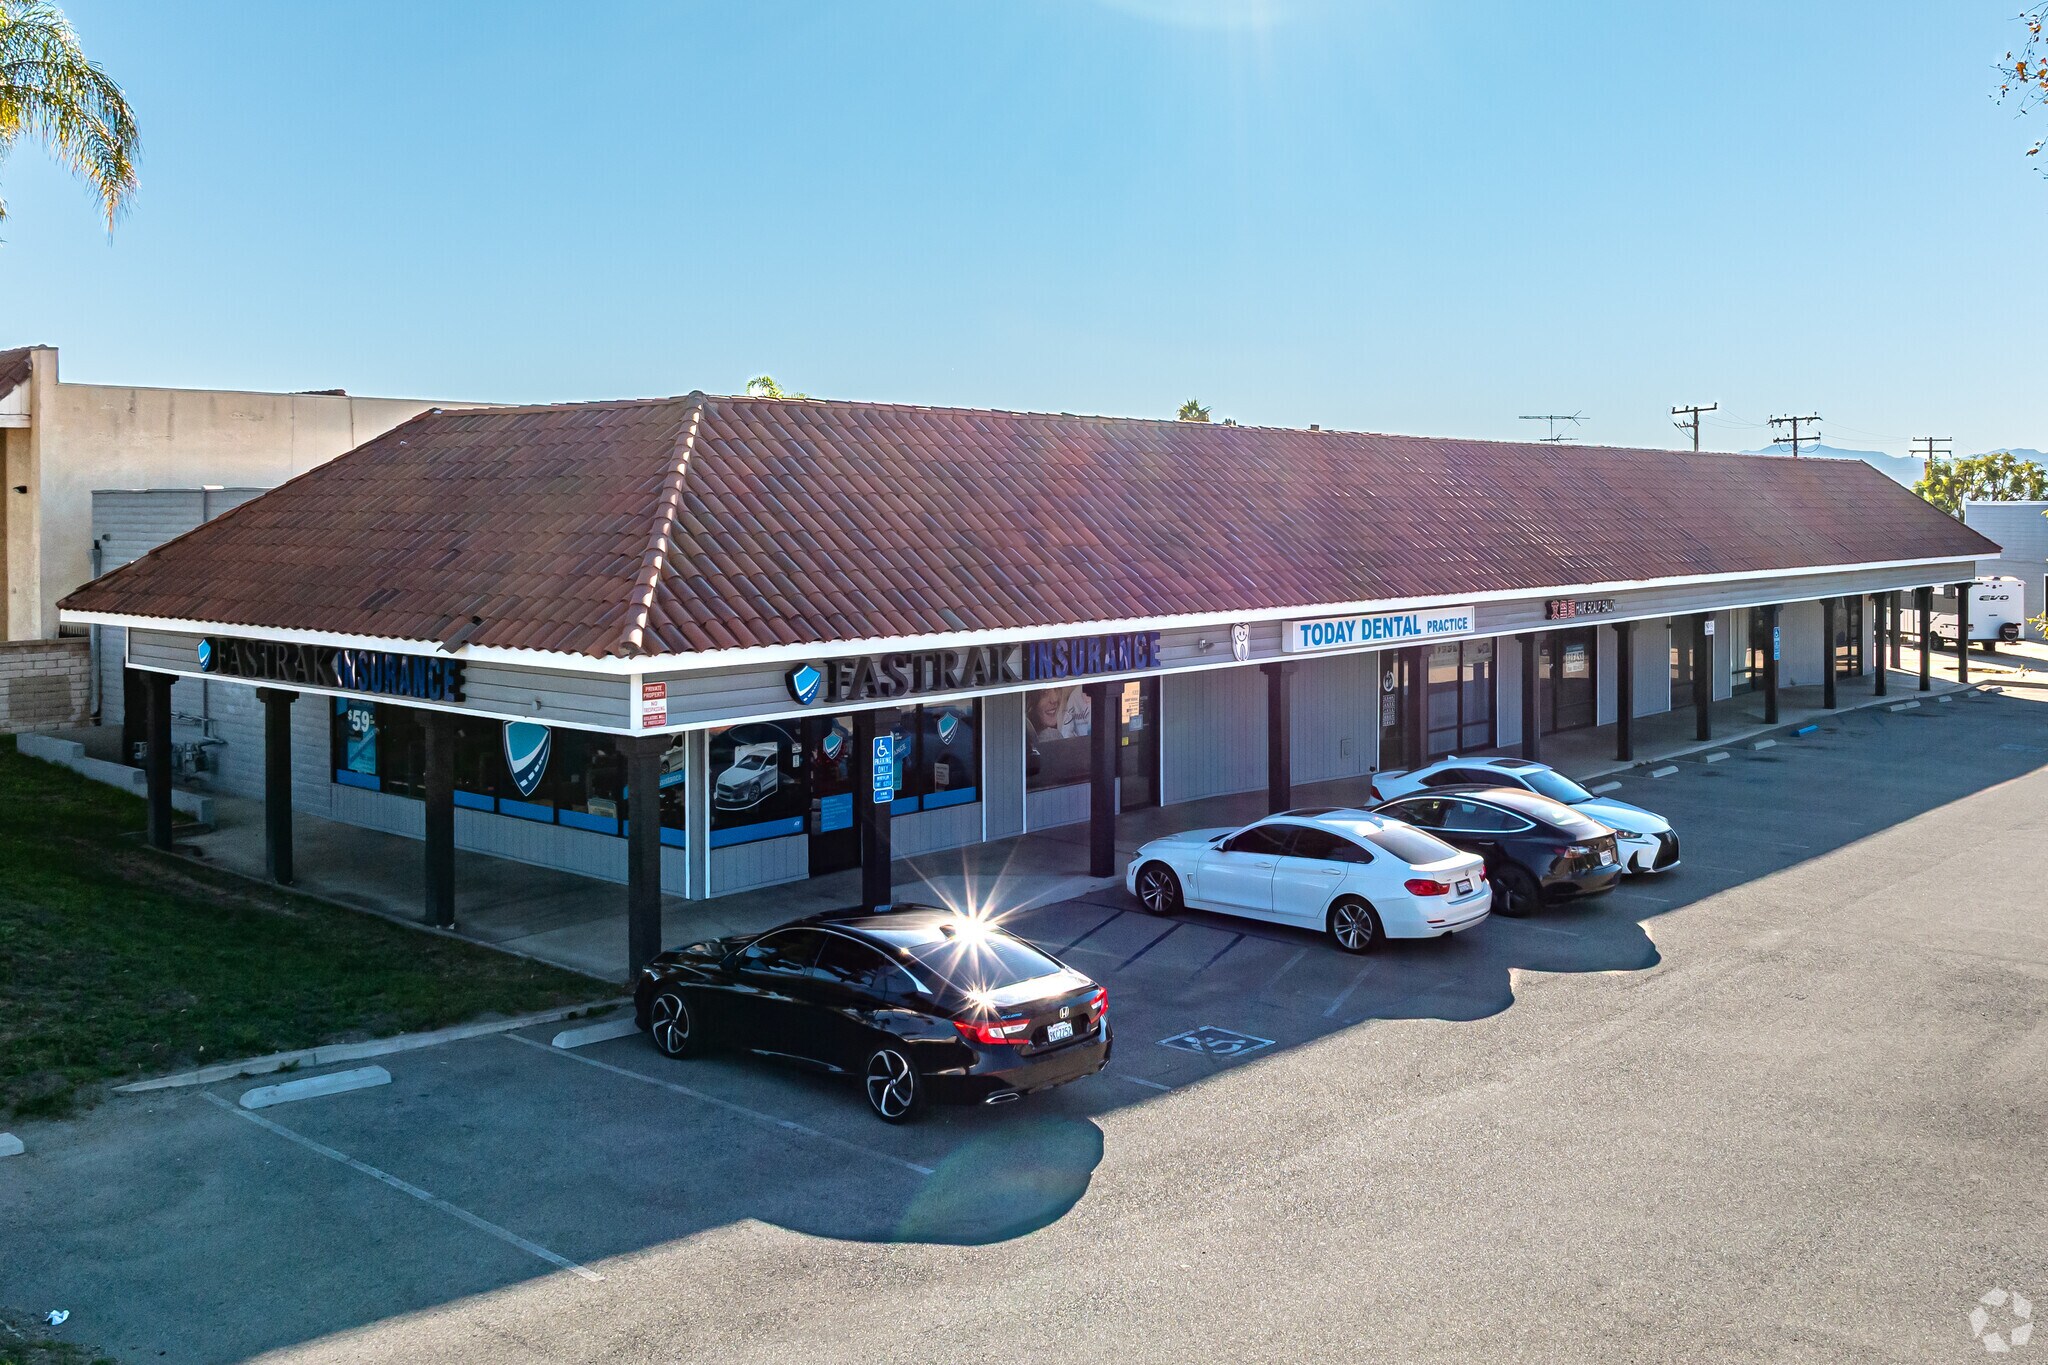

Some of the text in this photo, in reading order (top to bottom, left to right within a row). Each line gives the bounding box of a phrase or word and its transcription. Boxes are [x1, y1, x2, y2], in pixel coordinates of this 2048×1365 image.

[1301, 615, 1468, 646] TODAY DENTAL PRACTICE
[215, 637, 459, 702] FASTRAK INSURANCE
[824, 632, 1161, 703] FASTRAK INSURANCE
[874, 756, 891, 765] PARKING
